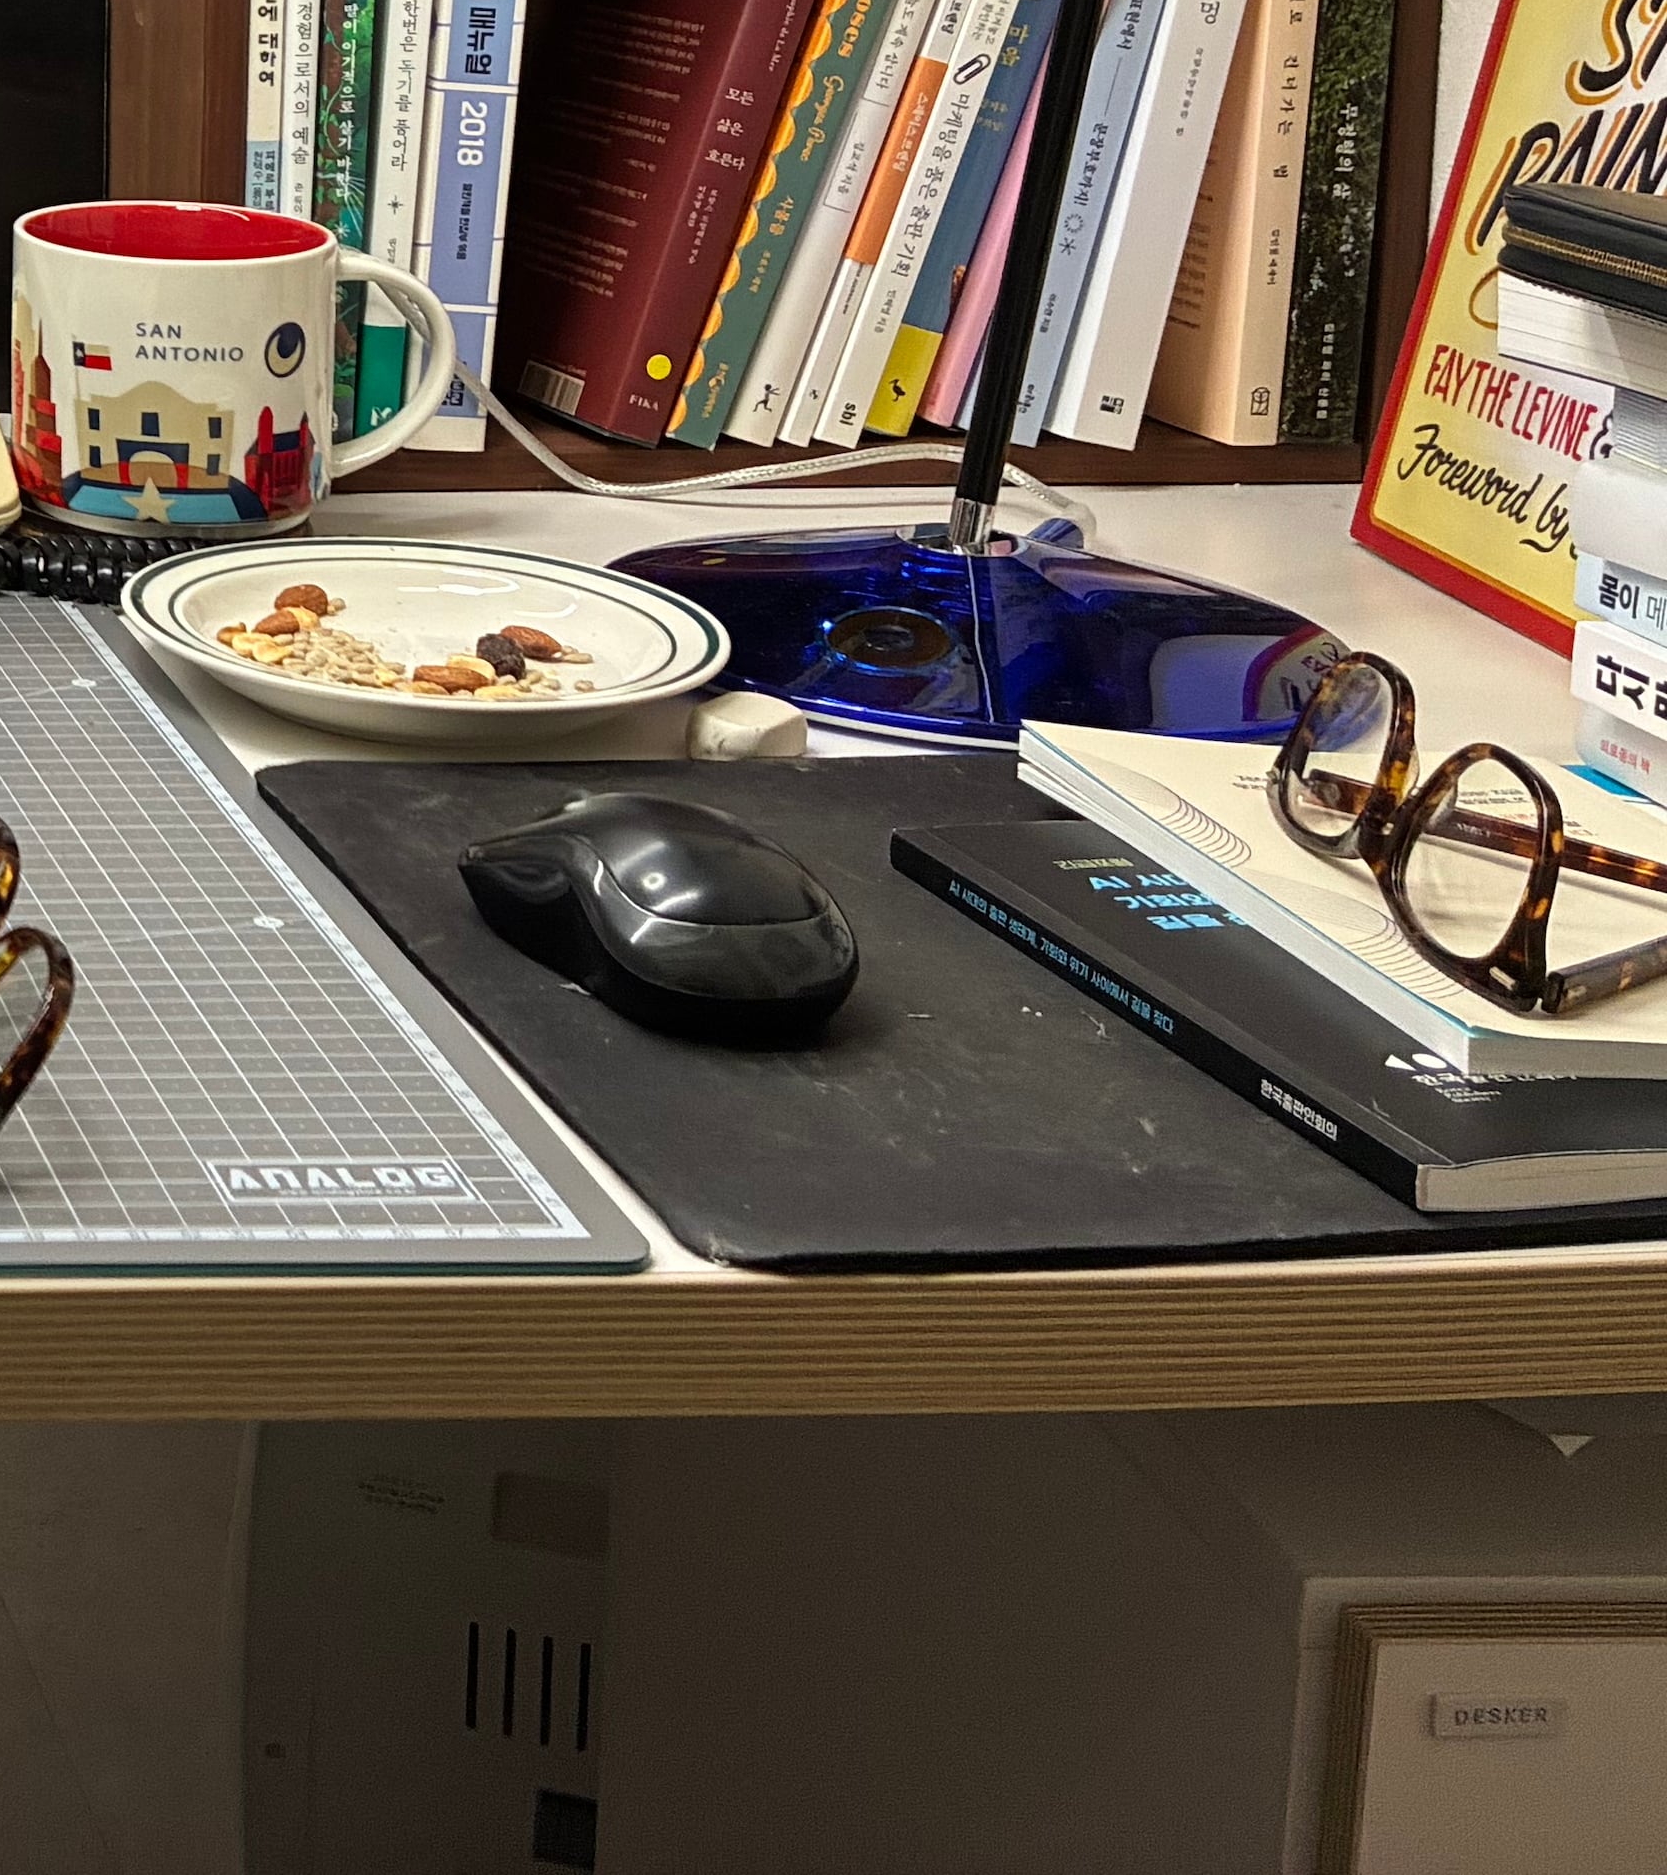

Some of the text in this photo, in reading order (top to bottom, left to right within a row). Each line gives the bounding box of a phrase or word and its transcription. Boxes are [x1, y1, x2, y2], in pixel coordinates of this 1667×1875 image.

[258, 33, 279, 87] 대하여
[464, 6, 497, 76] 매뉴얼
[290, 2, 313, 164] 경험으로서의 예술
[725, 87, 755, 106] 모든
[456, 101, 488, 167] 2018
[705, 148, 746, 171] 흐른다
[1336, 104, 1360, 174] 무정형의
[892, 94, 971, 278] 마케팅을 품은 출판 기획
[135, 345, 244, 362] ANTONIO
[136, 322, 182, 339] SAN
[629, 393, 660, 411] FIKA
[1423, 343, 1518, 429] FAYTHE
[1512, 379, 1598, 463] LEVINE
[1398, 423, 1570, 552] Foreword by
[1598, 572, 1640, 619] 몸이
[1595, 653, 1649, 710] 다시
[1261, 1079, 1339, 1141] 한국출판인회의
[228, 1165, 456, 1190] ANALOG
[1455, 1707, 1547, 1726] DESKER
